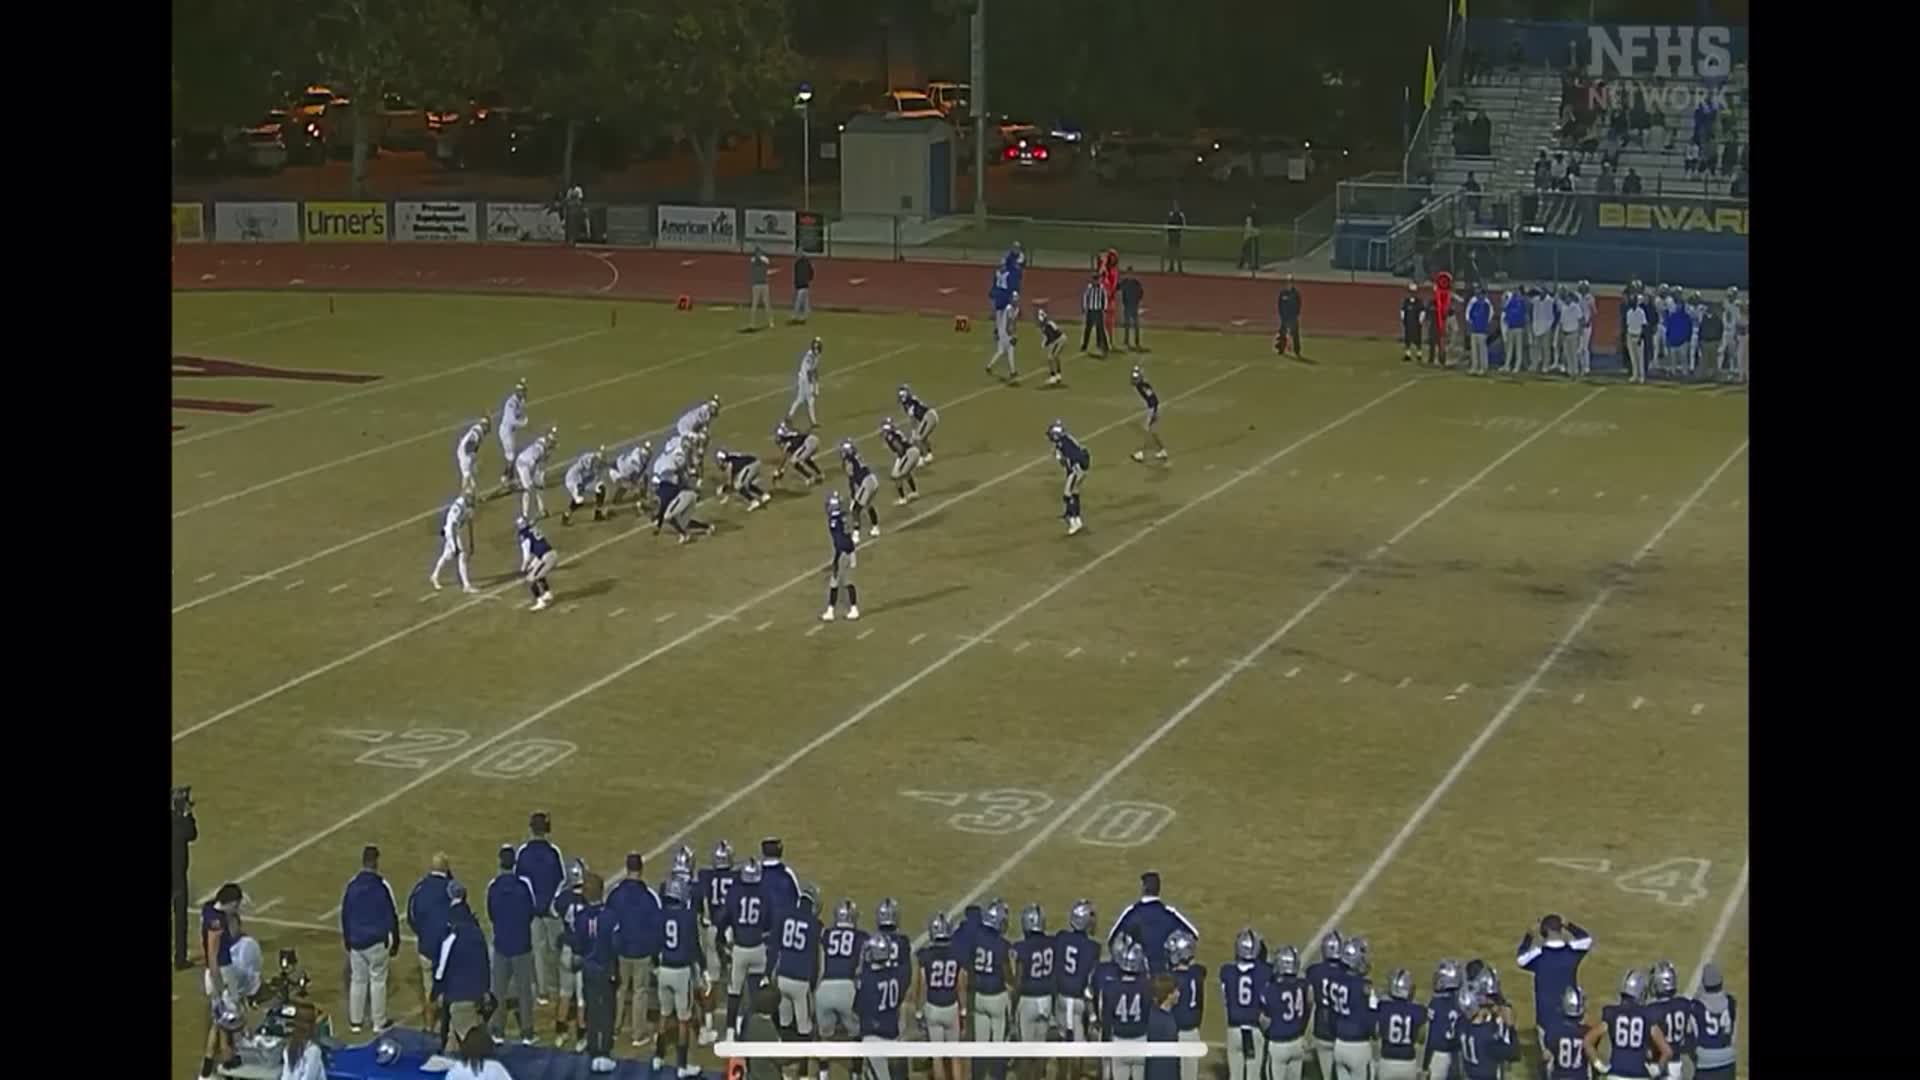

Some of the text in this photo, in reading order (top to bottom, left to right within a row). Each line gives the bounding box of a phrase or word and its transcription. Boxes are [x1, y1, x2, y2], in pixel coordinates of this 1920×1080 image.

[306, 207, 385, 236] Urner's
[660, 218, 708, 234] American
[711, 213, 734, 236] Kids
[354, 728, 578, 780] 20
[947, 787, 1177, 848] 30
[711, 878, 734, 906] 15
[738, 897, 761, 924] 16
[664, 919, 678, 949] 9
[782, 918, 809, 951] 85
[827, 929, 855, 957] 58
[929, 960, 957, 988] 28
[974, 947, 993, 974] 21
[1031, 947, 1054, 978] 29
[1064, 946, 1078, 974] 5
[877, 978, 900, 1012] 70
[1237, 976, 1252, 1006] 6
[1281, 987, 1304, 1022] 34
[1114, 993, 1142, 1023] 44
[1705, 1009, 1732, 1036] 54
[1389, 1014, 1412, 1045] 61
[1615, 1016, 1644, 1048] 68
[1664, 1010, 1685, 1043] 19
[1558, 1037, 1584, 1069] 87
